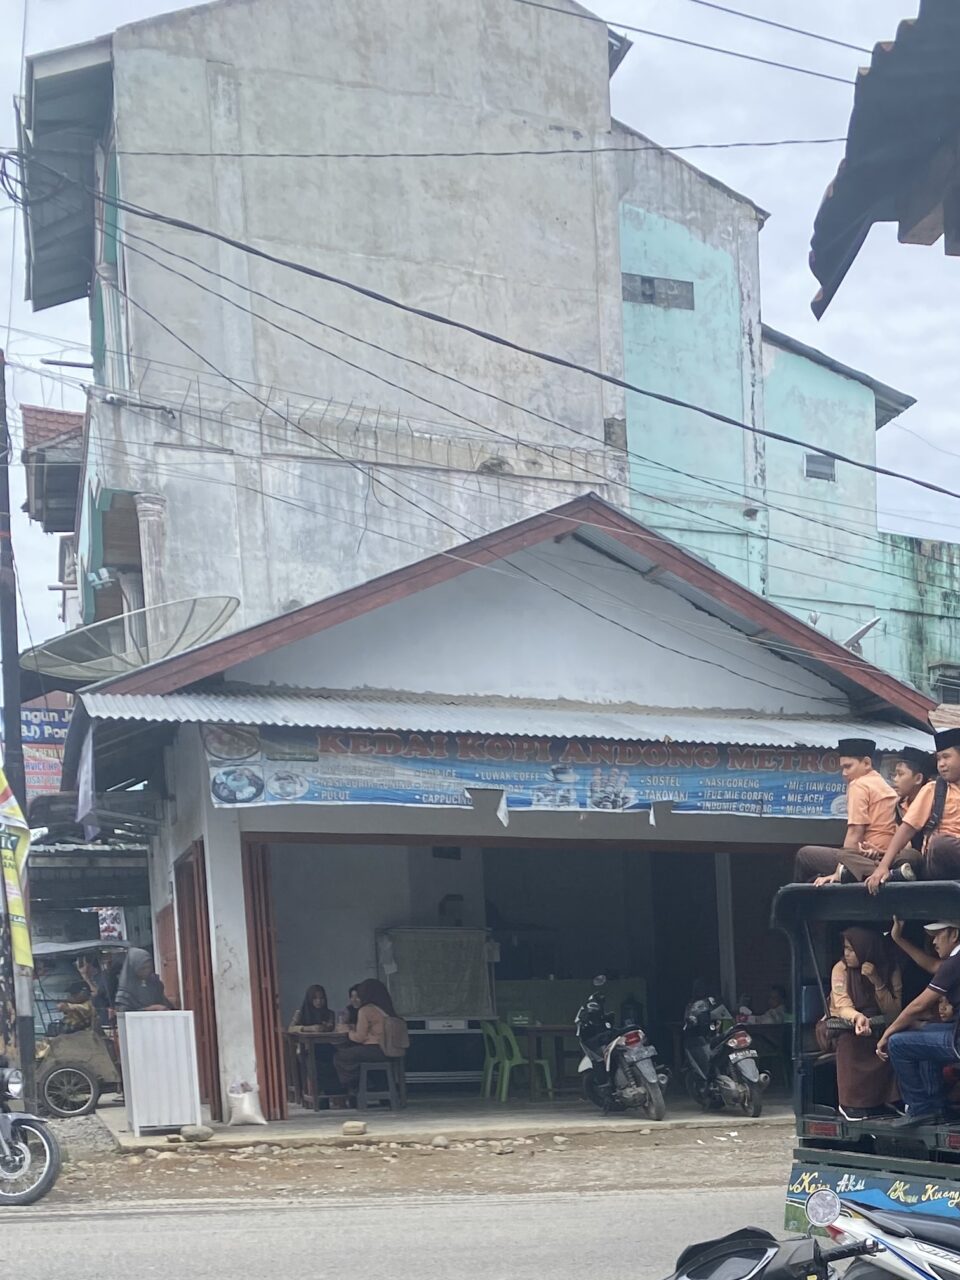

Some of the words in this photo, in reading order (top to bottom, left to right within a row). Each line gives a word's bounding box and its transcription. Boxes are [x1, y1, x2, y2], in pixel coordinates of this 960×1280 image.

[317, 732, 448, 759] KEDAI
[456, 735, 552, 762] KOPI
[559, 740, 720, 769] ANDONG
[727, 746, 841, 774] METRO
[726, 779, 760, 789] GORENG
[741, 791, 774, 801] GORENG
[787, 794, 804, 803] MIE
[804, 794, 824, 803] ACEH
